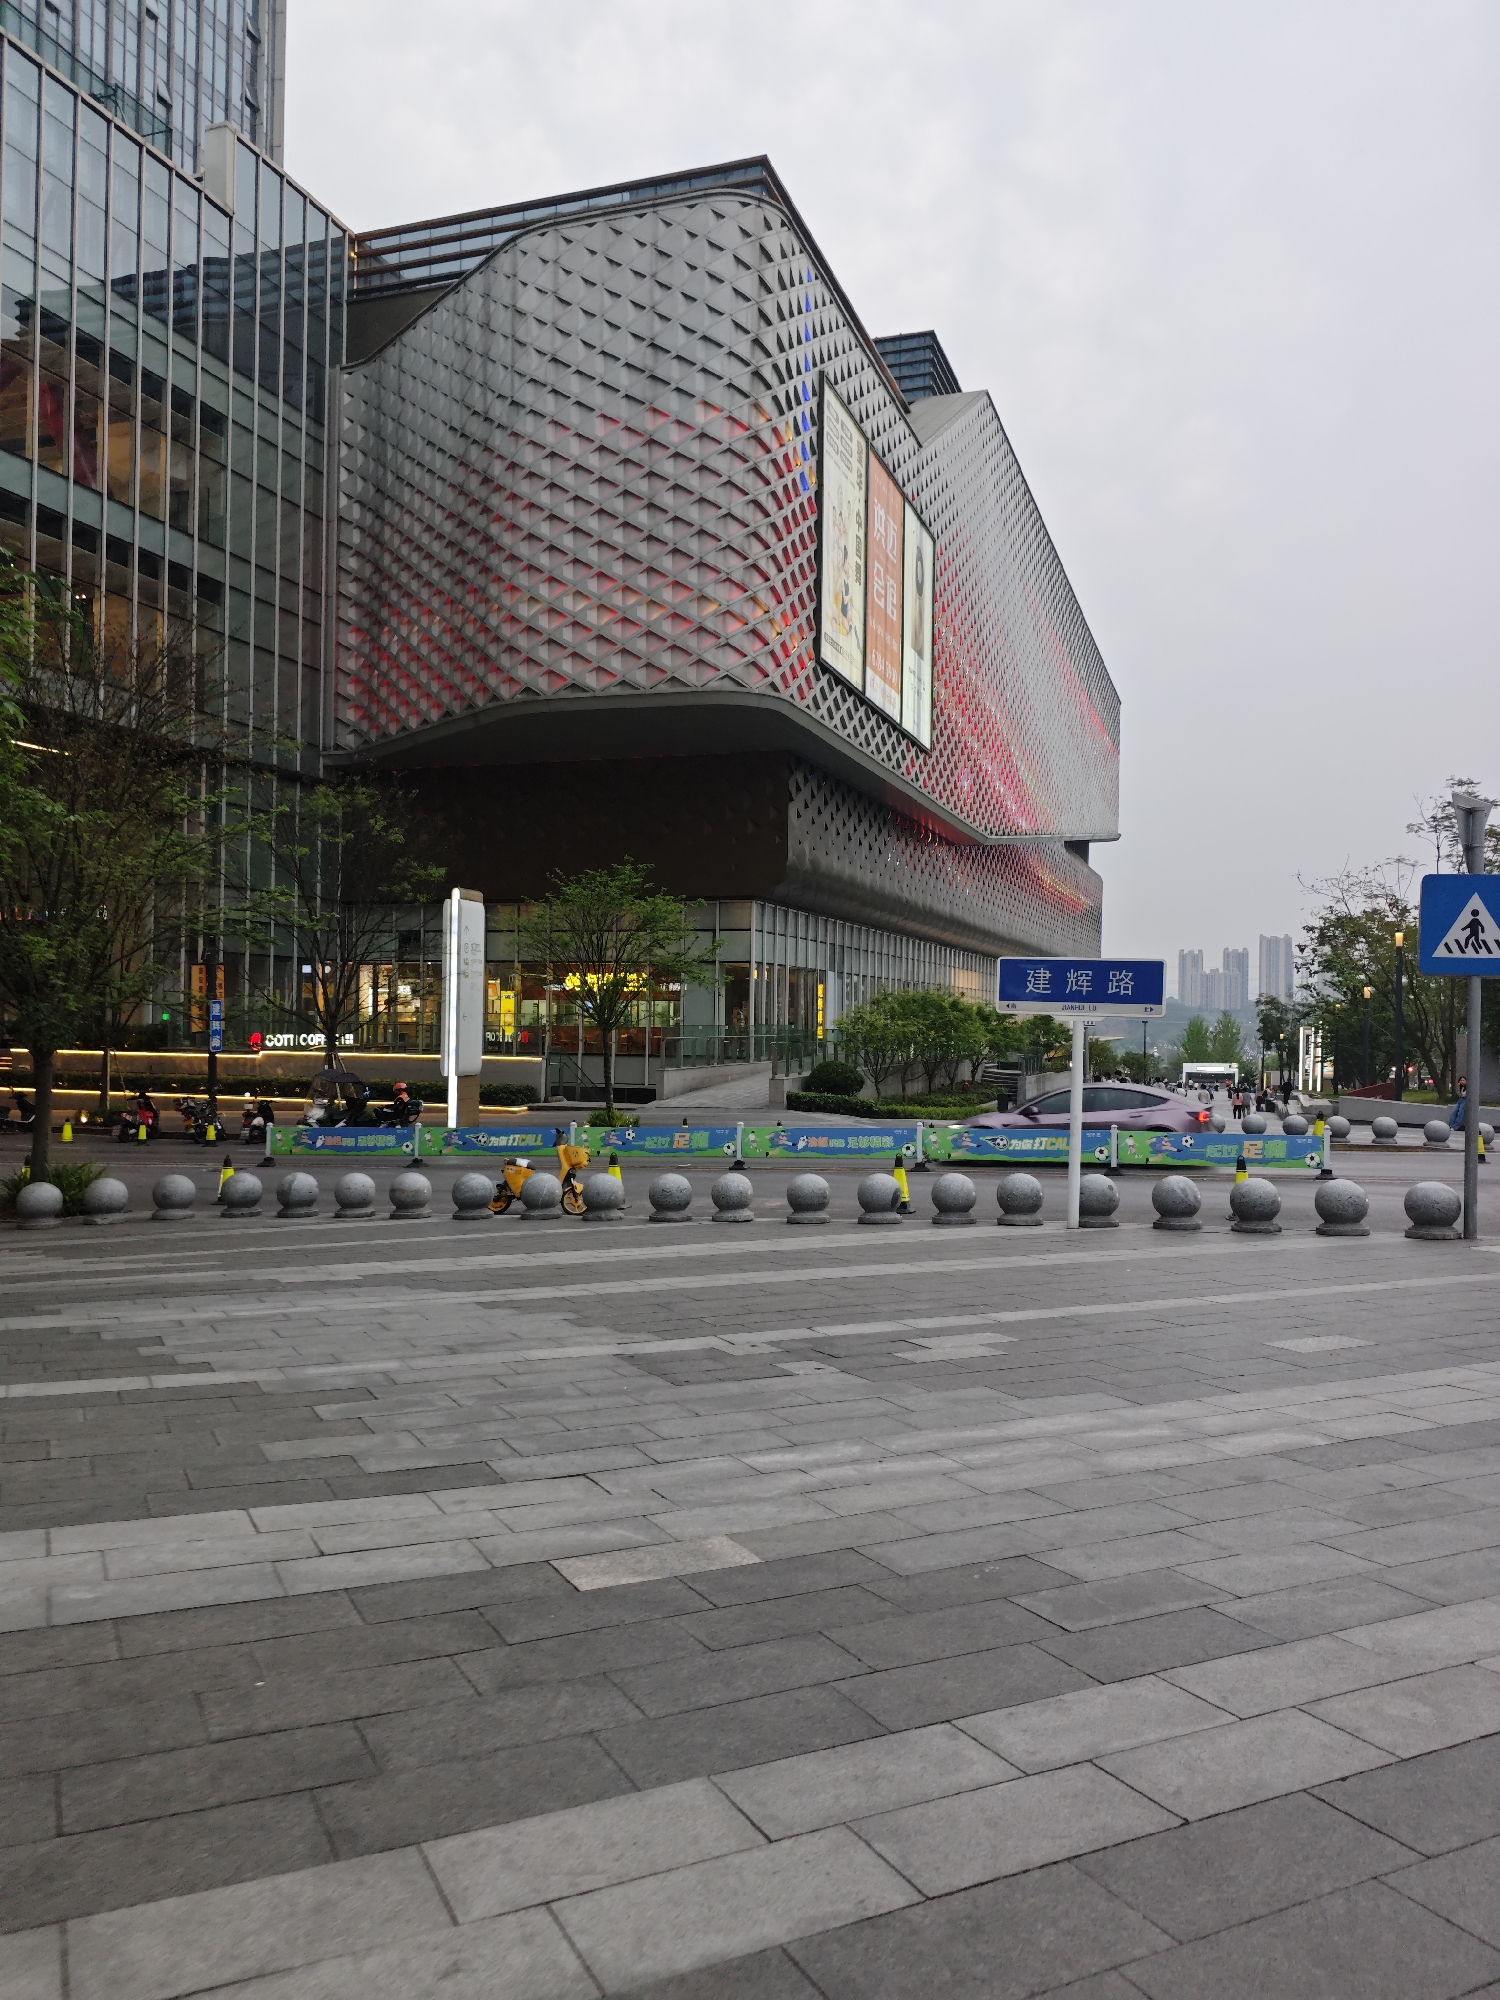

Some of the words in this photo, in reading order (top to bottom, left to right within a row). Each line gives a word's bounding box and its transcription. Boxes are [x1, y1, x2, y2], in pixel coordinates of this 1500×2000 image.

[1025, 967, 1135, 996] 建辉路
[1061, 1004, 1085, 1012] JIANHUI
[1088, 1004, 1097, 1012] LU
[1009, 1137, 1071, 1151] 为你打CAL
